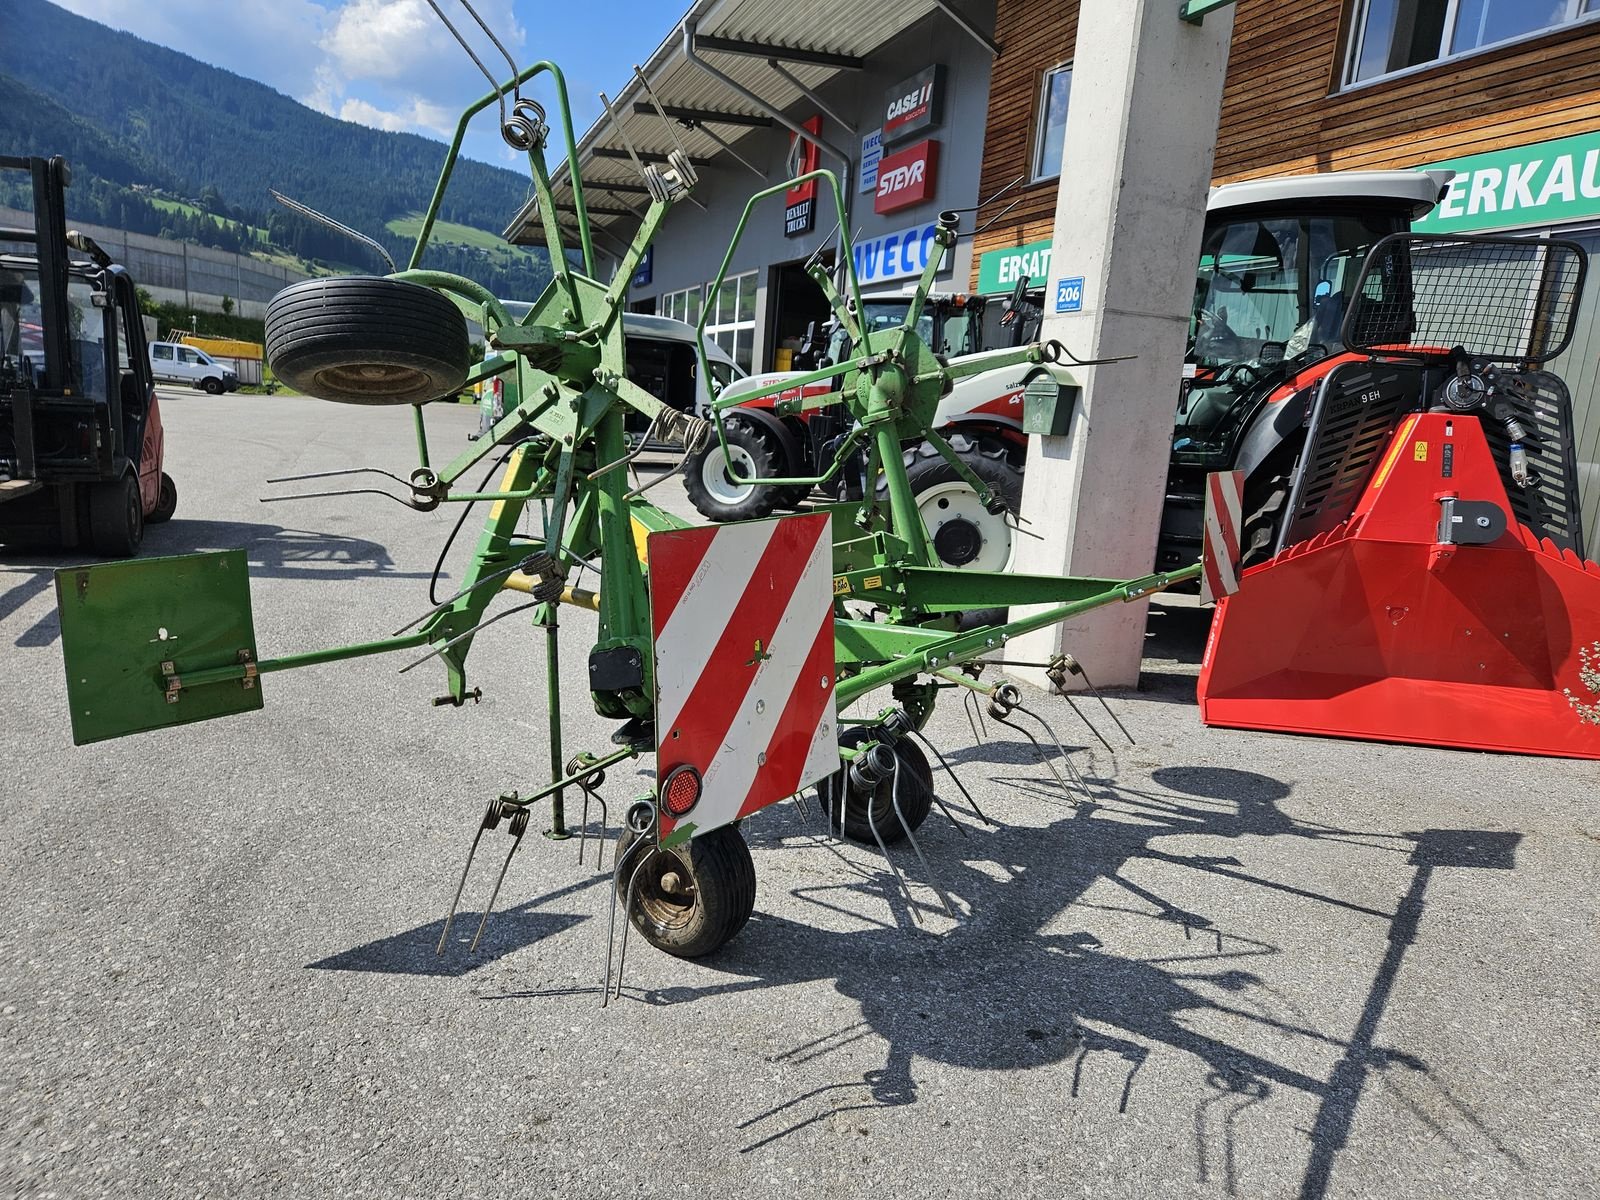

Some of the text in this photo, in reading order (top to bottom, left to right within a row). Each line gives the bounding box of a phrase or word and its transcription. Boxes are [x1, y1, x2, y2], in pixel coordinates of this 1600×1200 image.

[887, 89, 919, 120] CASE
[877, 159, 925, 197] STEYR
[998, 248, 1052, 284] ERSAT
[1058, 286, 1080, 303] 206
[1361, 394, 1368, 403] 9
[1369, 390, 1381, 401] EH
